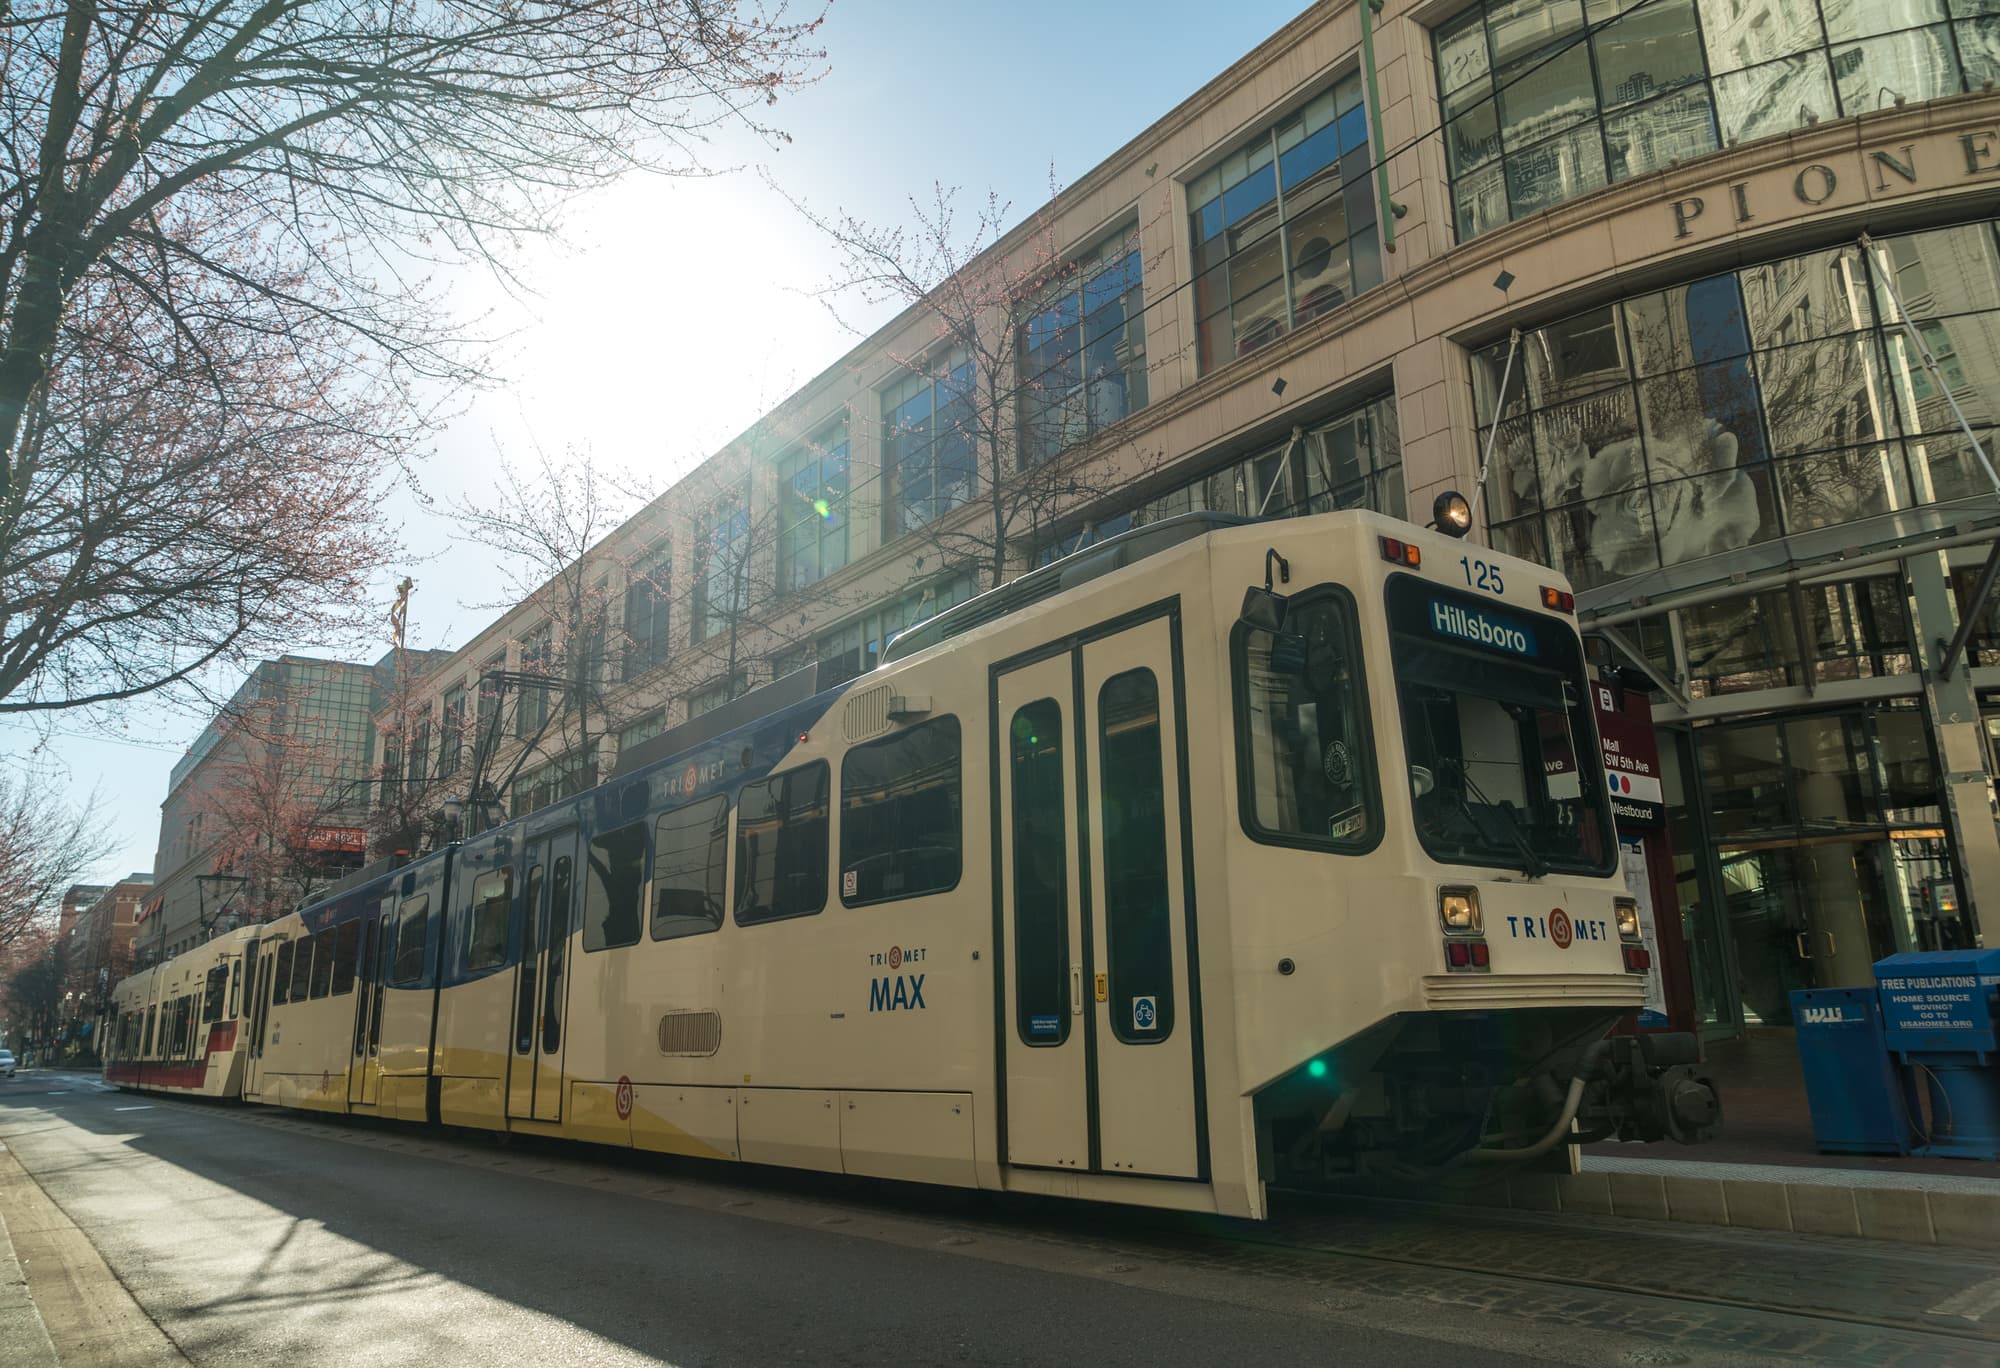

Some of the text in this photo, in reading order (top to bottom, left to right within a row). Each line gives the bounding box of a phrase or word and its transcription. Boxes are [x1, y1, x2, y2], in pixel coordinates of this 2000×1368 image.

[1669, 130, 2000, 240] PIONE
[1460, 556, 1504, 595] 125
[1433, 602, 1527, 653] Hillsboro
[1603, 737, 1620, 752] Mall
[1604, 752, 1650, 773] SW 5th Ave
[1611, 802, 1653, 820] Westbound
[869, 974, 926, 1012] MAX
[1881, 979, 1906, 990] FREE
[1907, 976, 1977, 989] PUBLICATIONS
[1892, 994, 1971, 1003] HOME SOURCE
